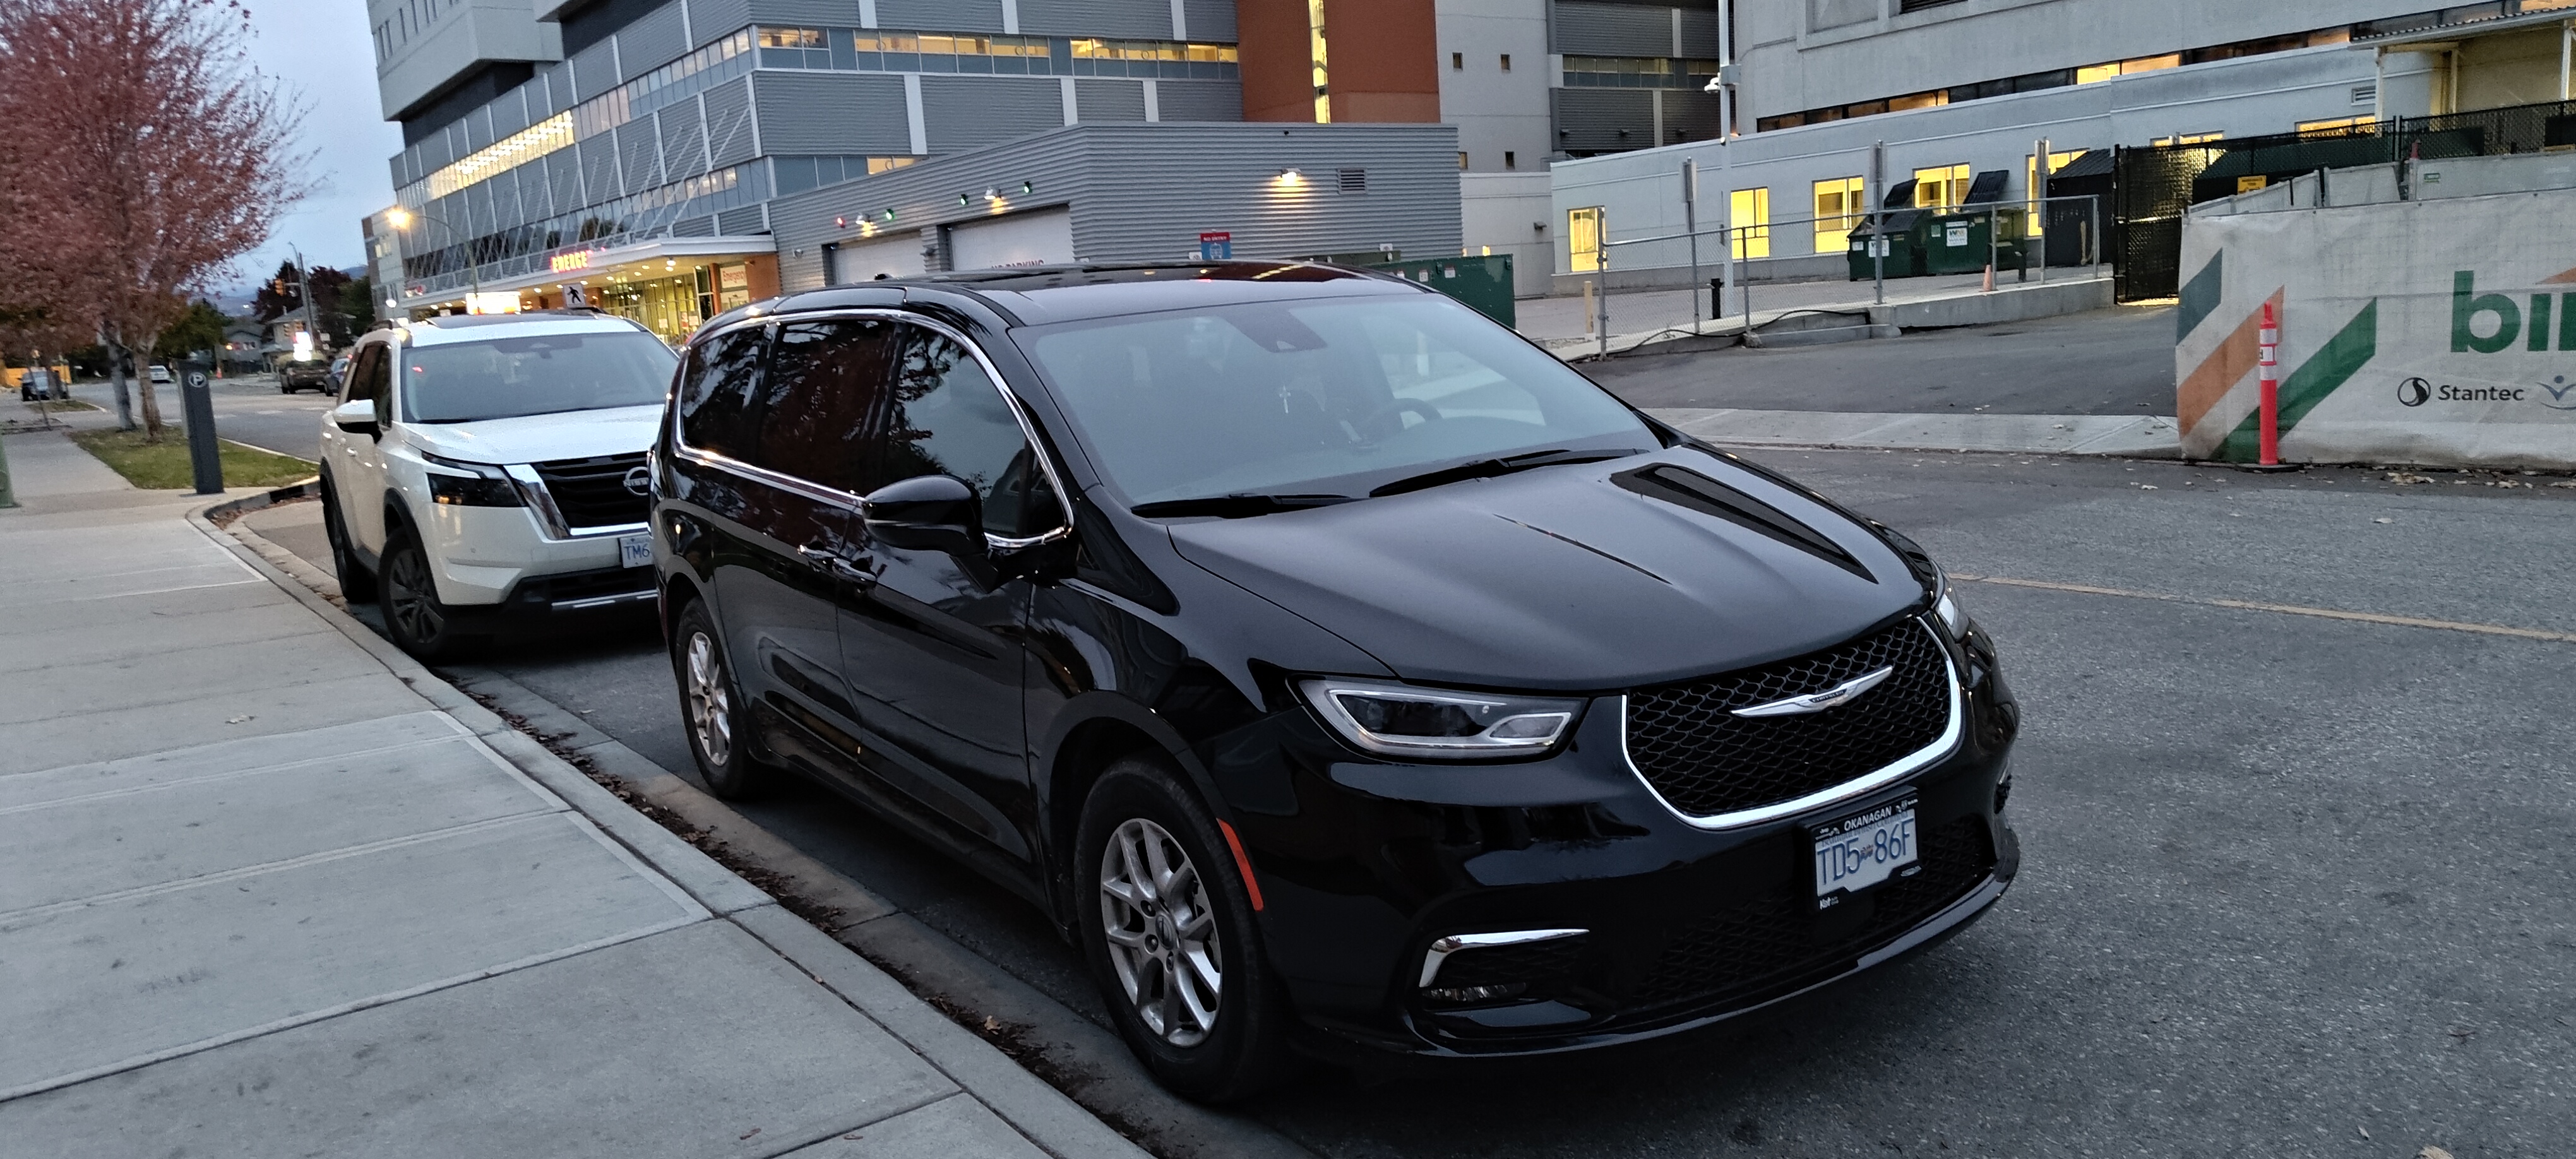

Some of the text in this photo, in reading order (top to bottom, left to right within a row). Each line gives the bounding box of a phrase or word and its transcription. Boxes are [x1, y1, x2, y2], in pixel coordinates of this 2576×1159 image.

[722, 270, 746, 283] Emergency
[2438, 384, 2525, 401] Stantec
[624, 543, 650, 560] TM6
[1844, 805, 1892, 831] OKANAGAN
